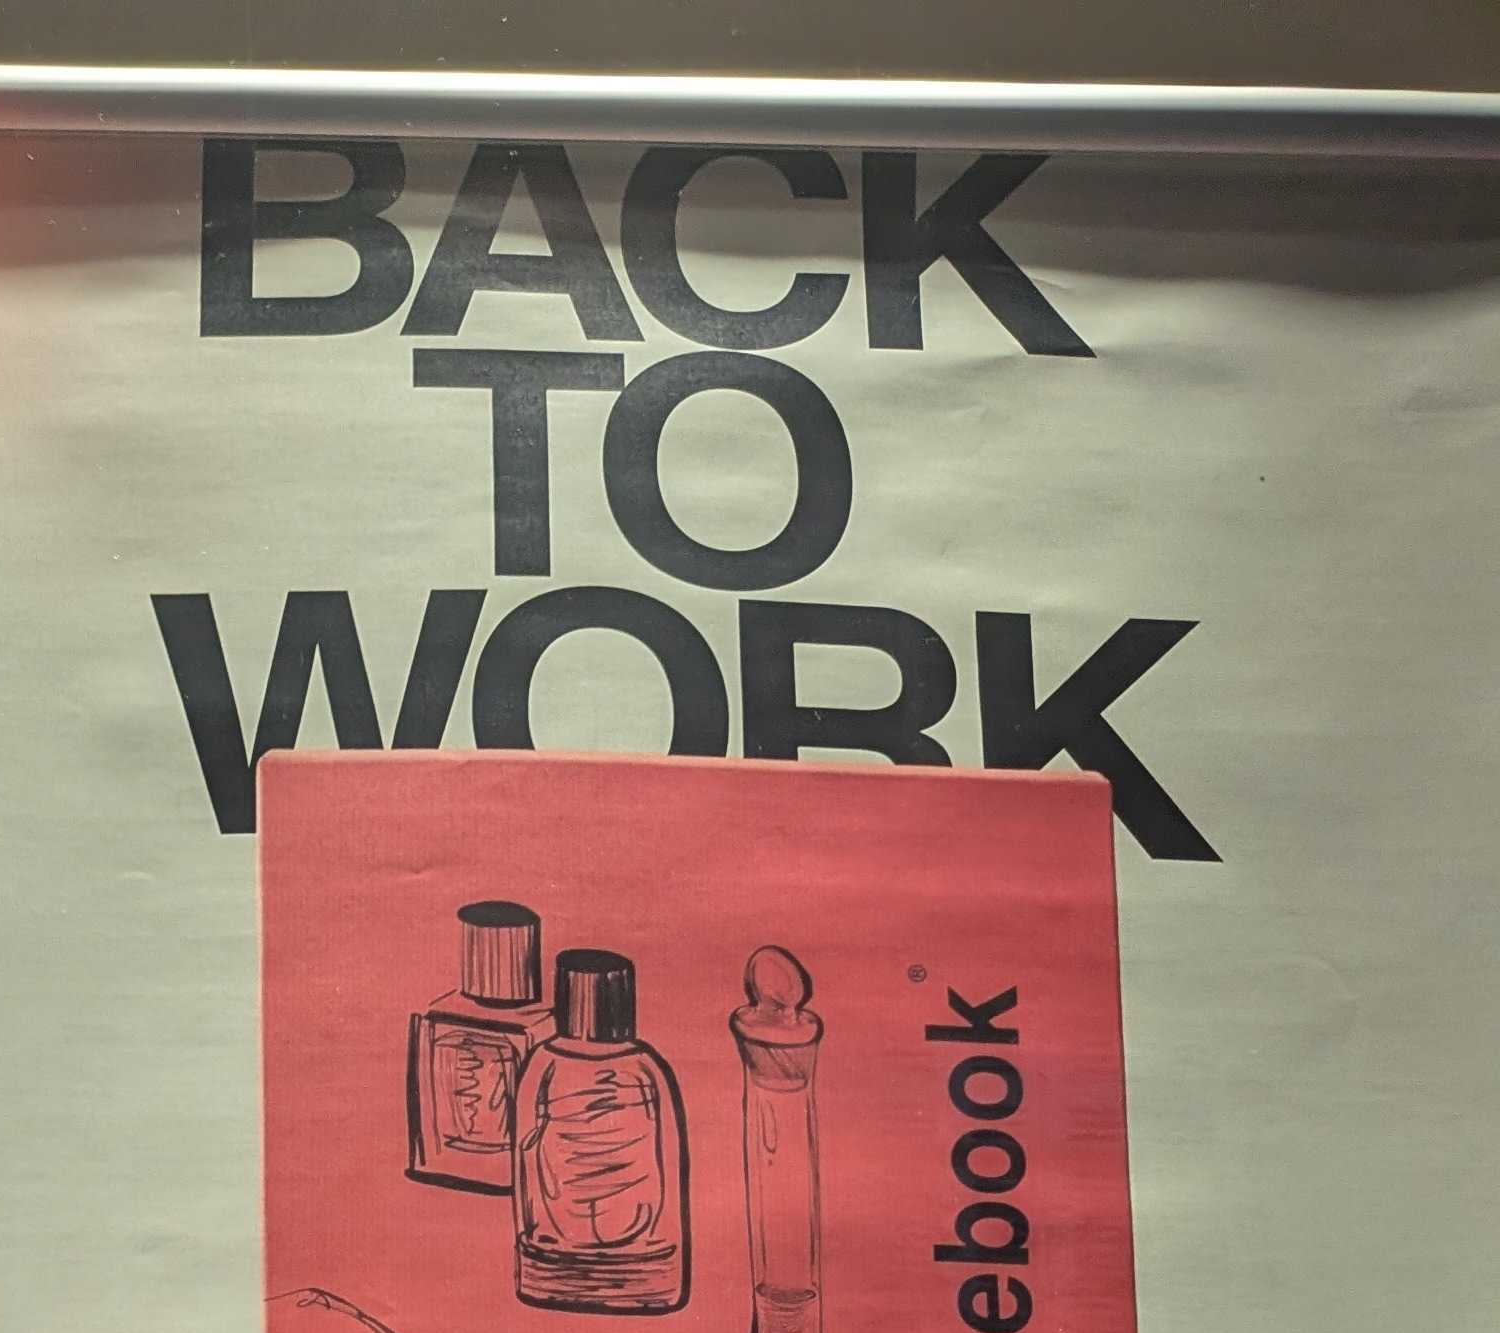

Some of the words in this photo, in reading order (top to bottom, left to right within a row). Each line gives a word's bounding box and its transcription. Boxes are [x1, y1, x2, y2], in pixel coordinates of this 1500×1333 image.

[200, 137, 1096, 357] BACK
[412, 347, 853, 591] TO
[150, 585, 1223, 862] WORK
